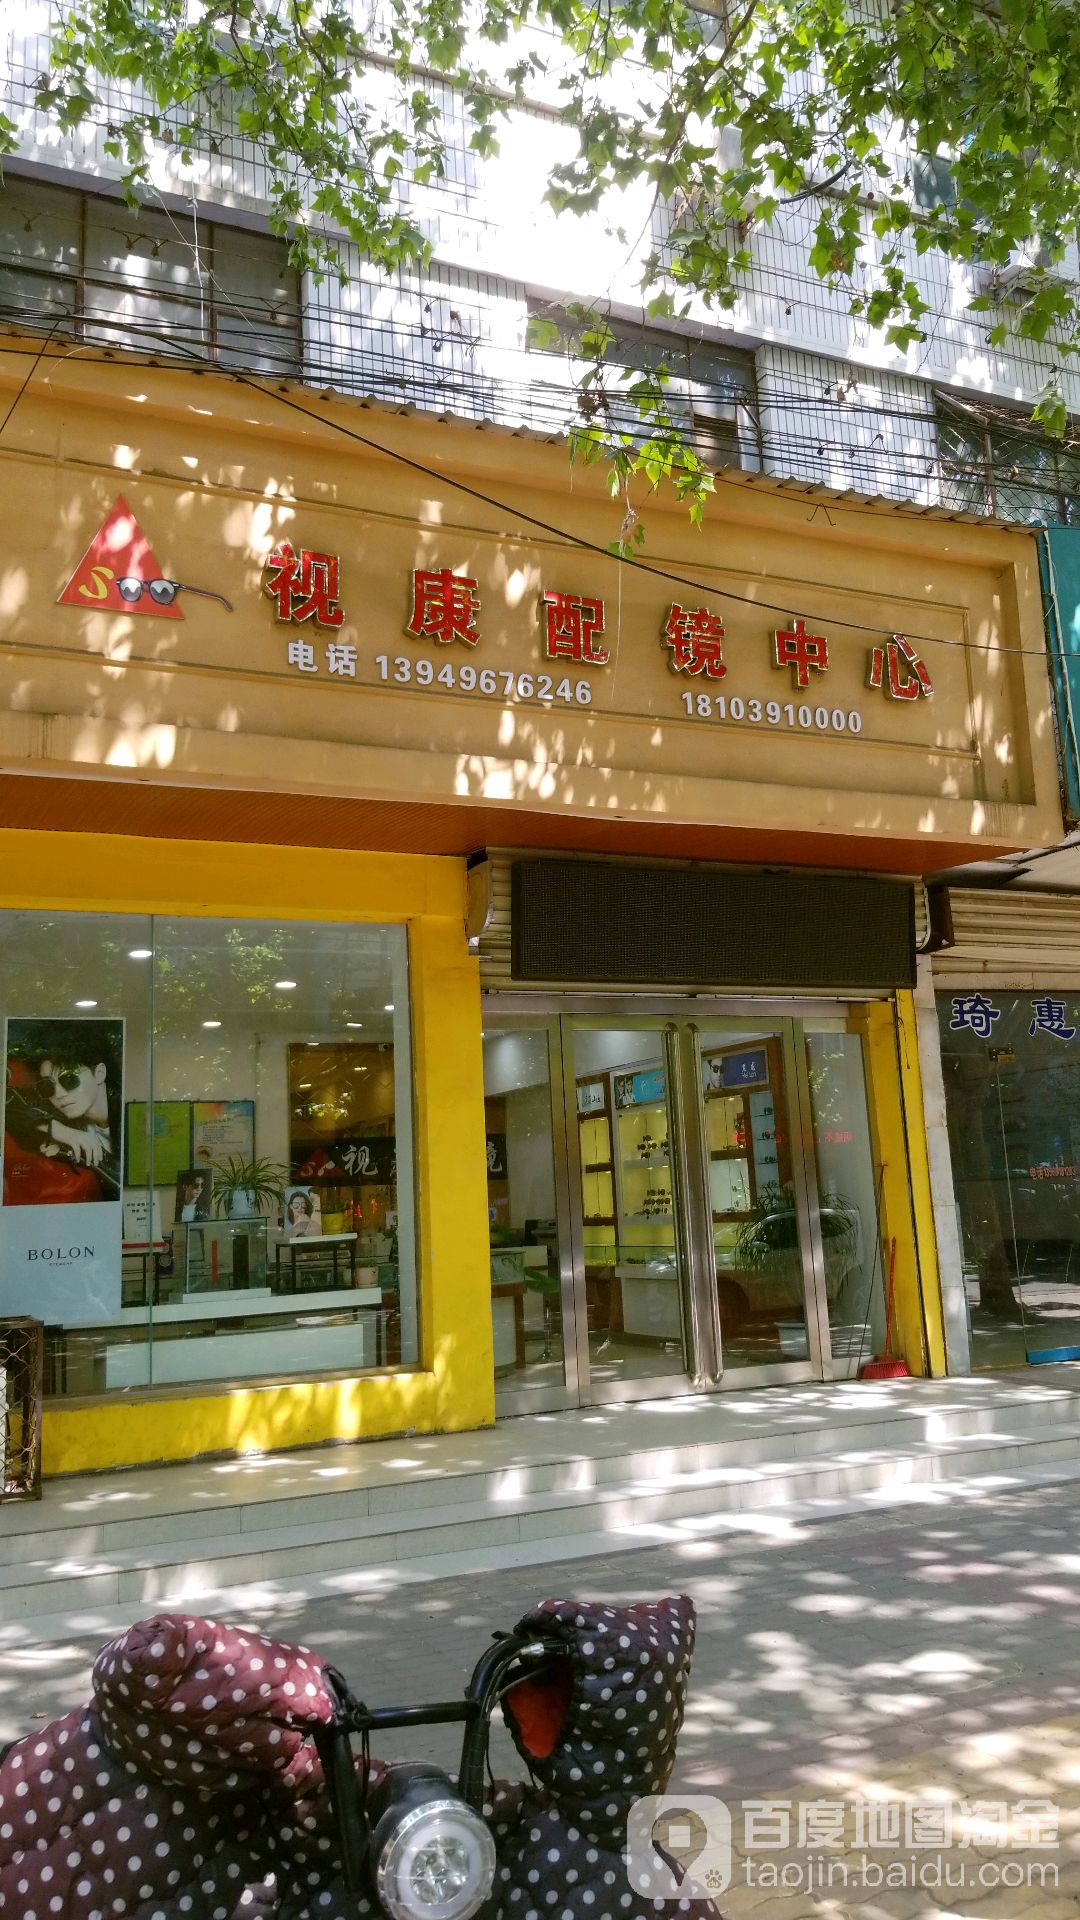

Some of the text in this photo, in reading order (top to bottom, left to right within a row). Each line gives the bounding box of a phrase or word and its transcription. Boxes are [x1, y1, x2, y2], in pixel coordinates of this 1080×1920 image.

[265, 544, 935, 702] 视康配镜中心
[286, 639, 592, 705] 电话 13949676246
[681, 692, 863, 734] 18103910000
[950, 993, 1077, 1040] 琦惠
[27, 1246, 95, 1261] BOLON
